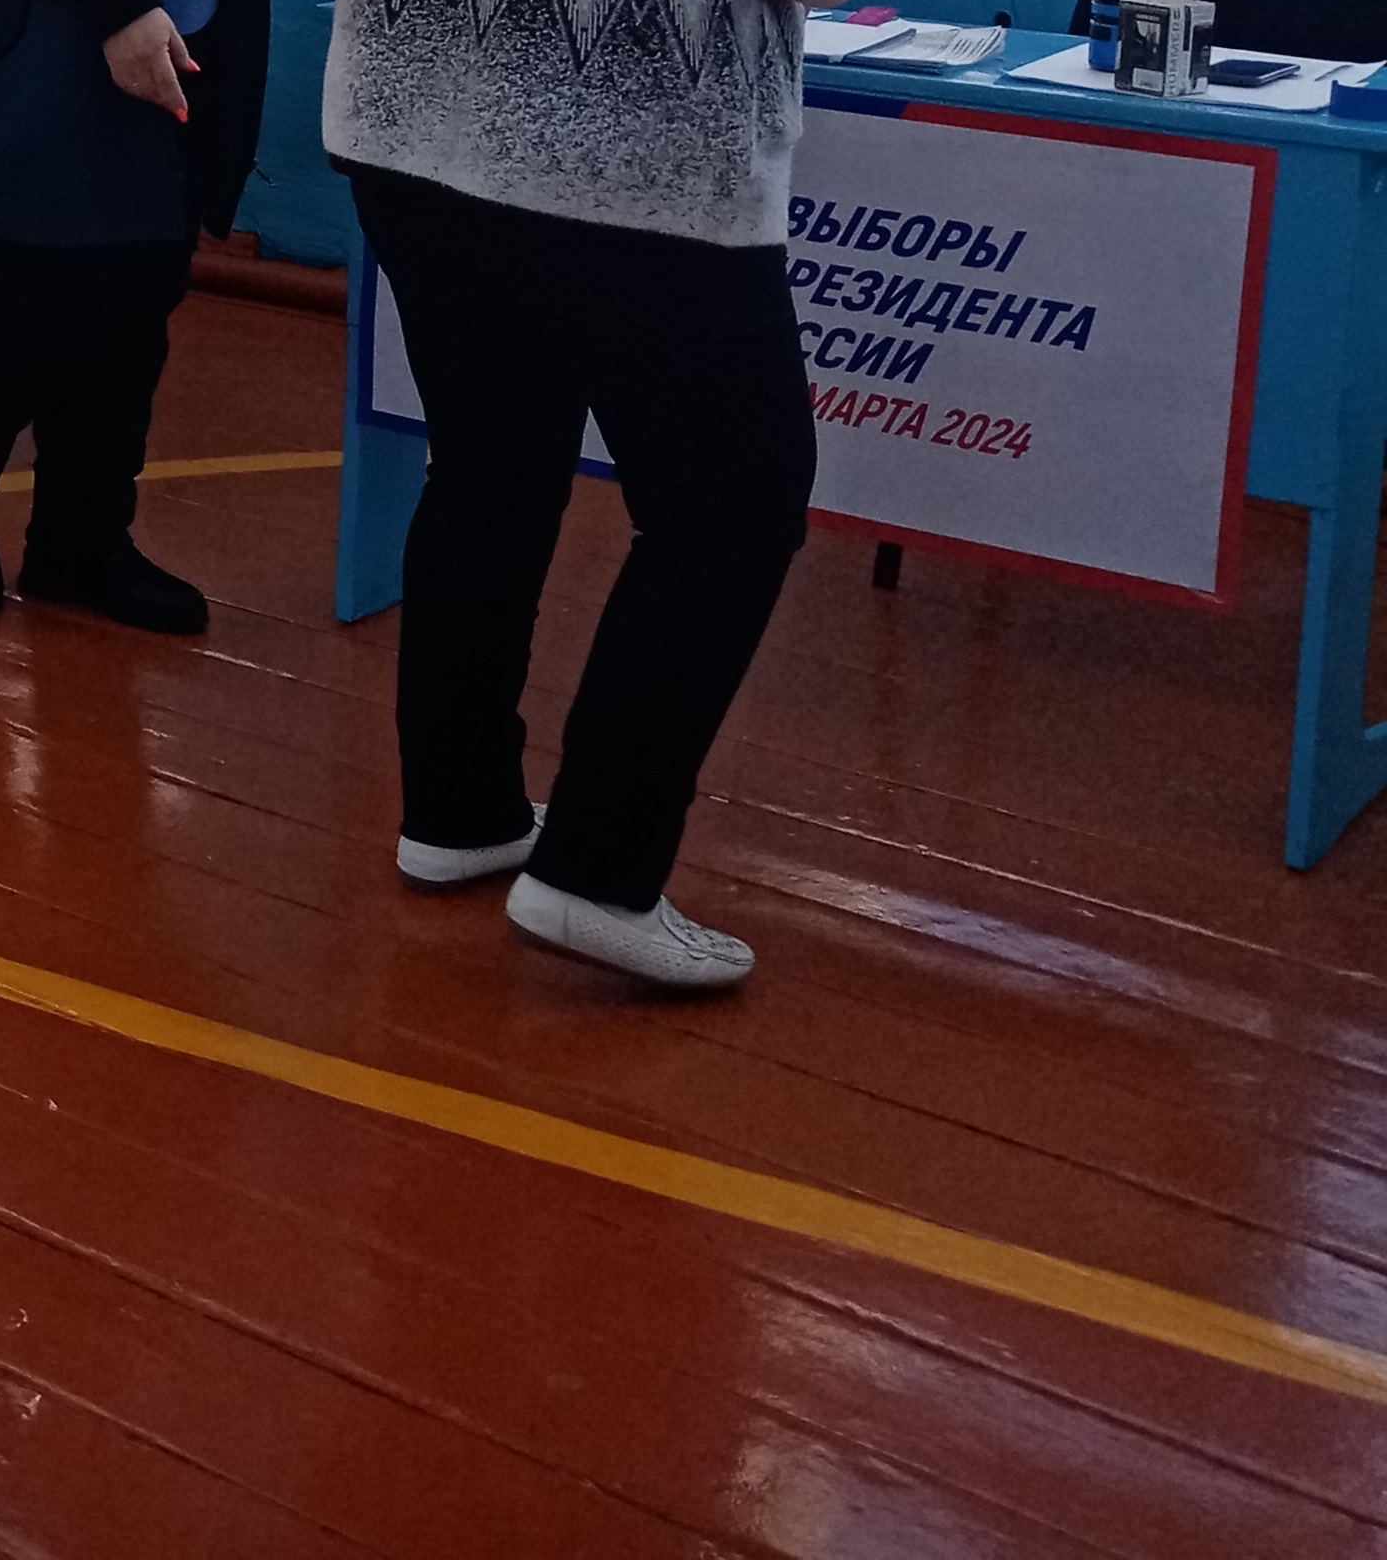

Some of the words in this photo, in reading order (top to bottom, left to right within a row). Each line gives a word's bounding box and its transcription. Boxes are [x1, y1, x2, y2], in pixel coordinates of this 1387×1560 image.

[788, 196, 1027, 273] ВЫБОРЫ
[787, 257, 1097, 352] РЕЗИДЕНТА
[808, 382, 929, 440] МАРТА
[930, 408, 1033, 459] 2024
